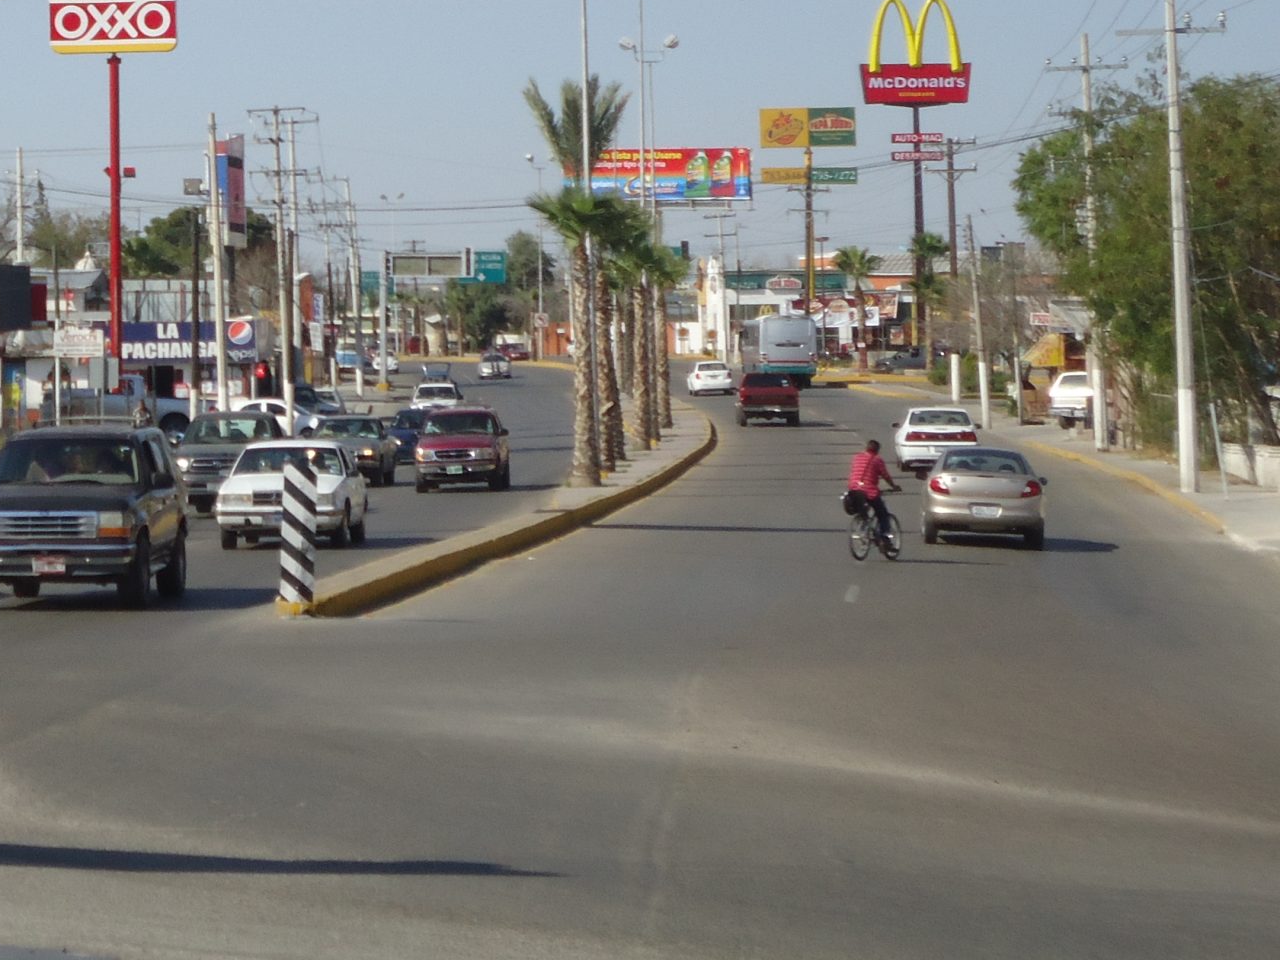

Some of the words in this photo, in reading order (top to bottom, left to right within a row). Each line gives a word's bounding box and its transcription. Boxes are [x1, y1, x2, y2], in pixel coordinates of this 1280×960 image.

[53, 0, 172, 40] OXXO
[868, 76, 966, 89] McDonald's
[156, 323, 180, 340] LA
[121, 341, 218, 359] PACHANGA
